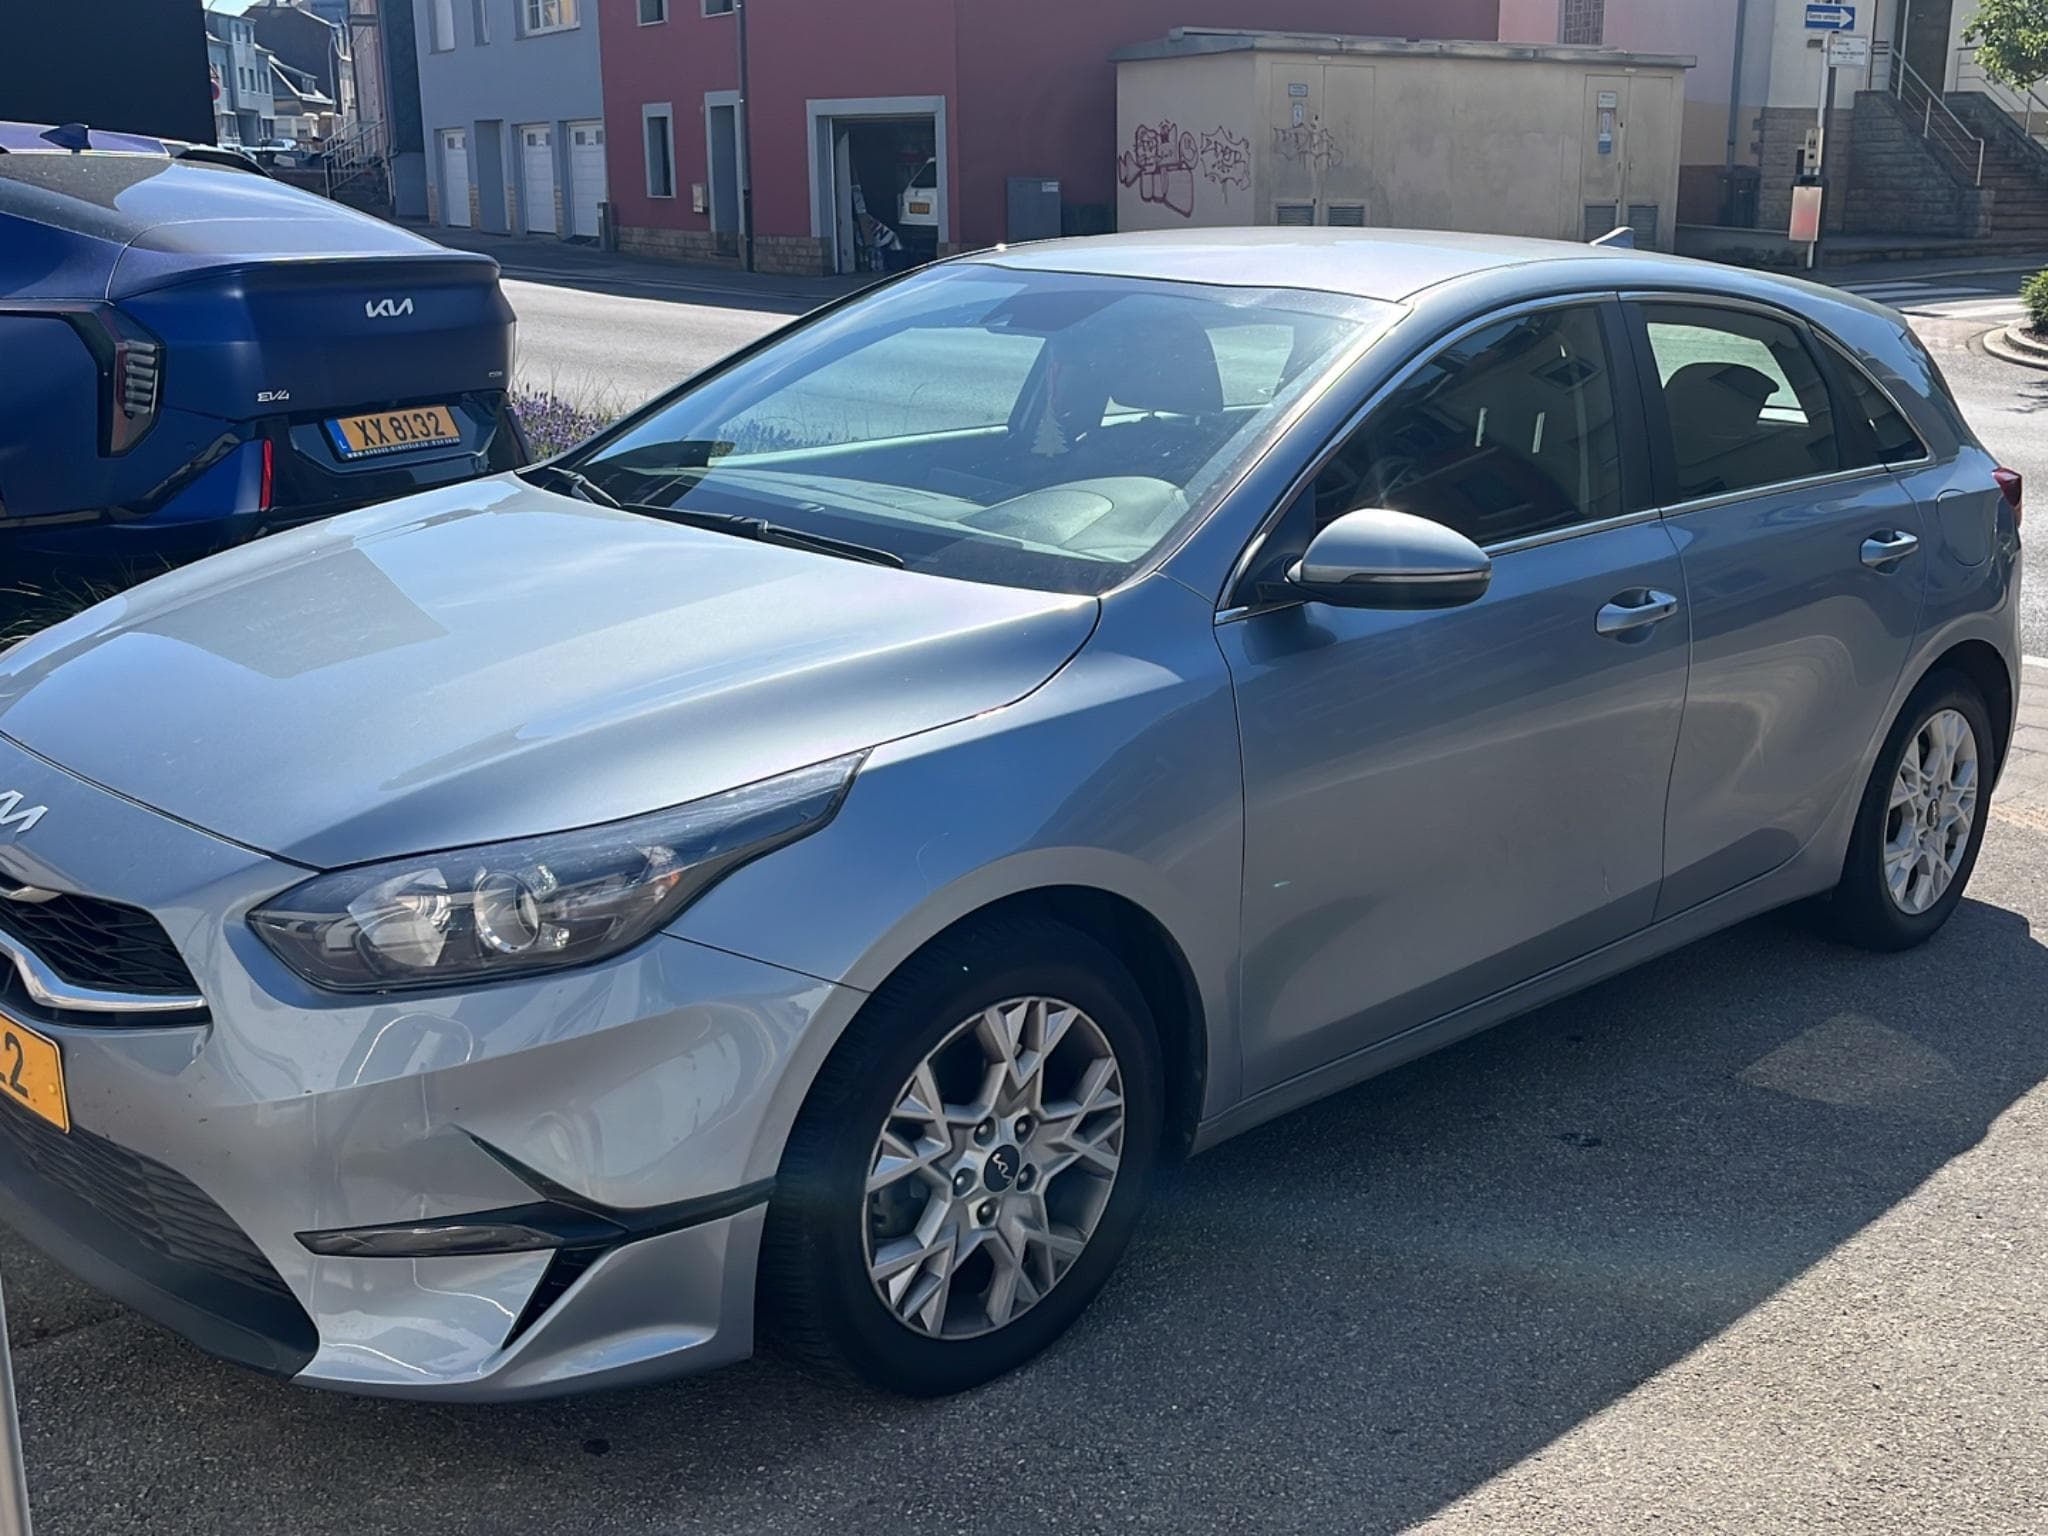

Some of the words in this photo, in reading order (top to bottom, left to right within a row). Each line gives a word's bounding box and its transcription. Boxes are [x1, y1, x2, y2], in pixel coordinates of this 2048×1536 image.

[365, 298, 414, 318] KIA
[257, 389, 290, 402] EV4
[354, 418, 390, 447] XX
[388, 411, 446, 442] 8132
[339, 440, 348, 450] L
[0, 1030, 30, 1099] 2
